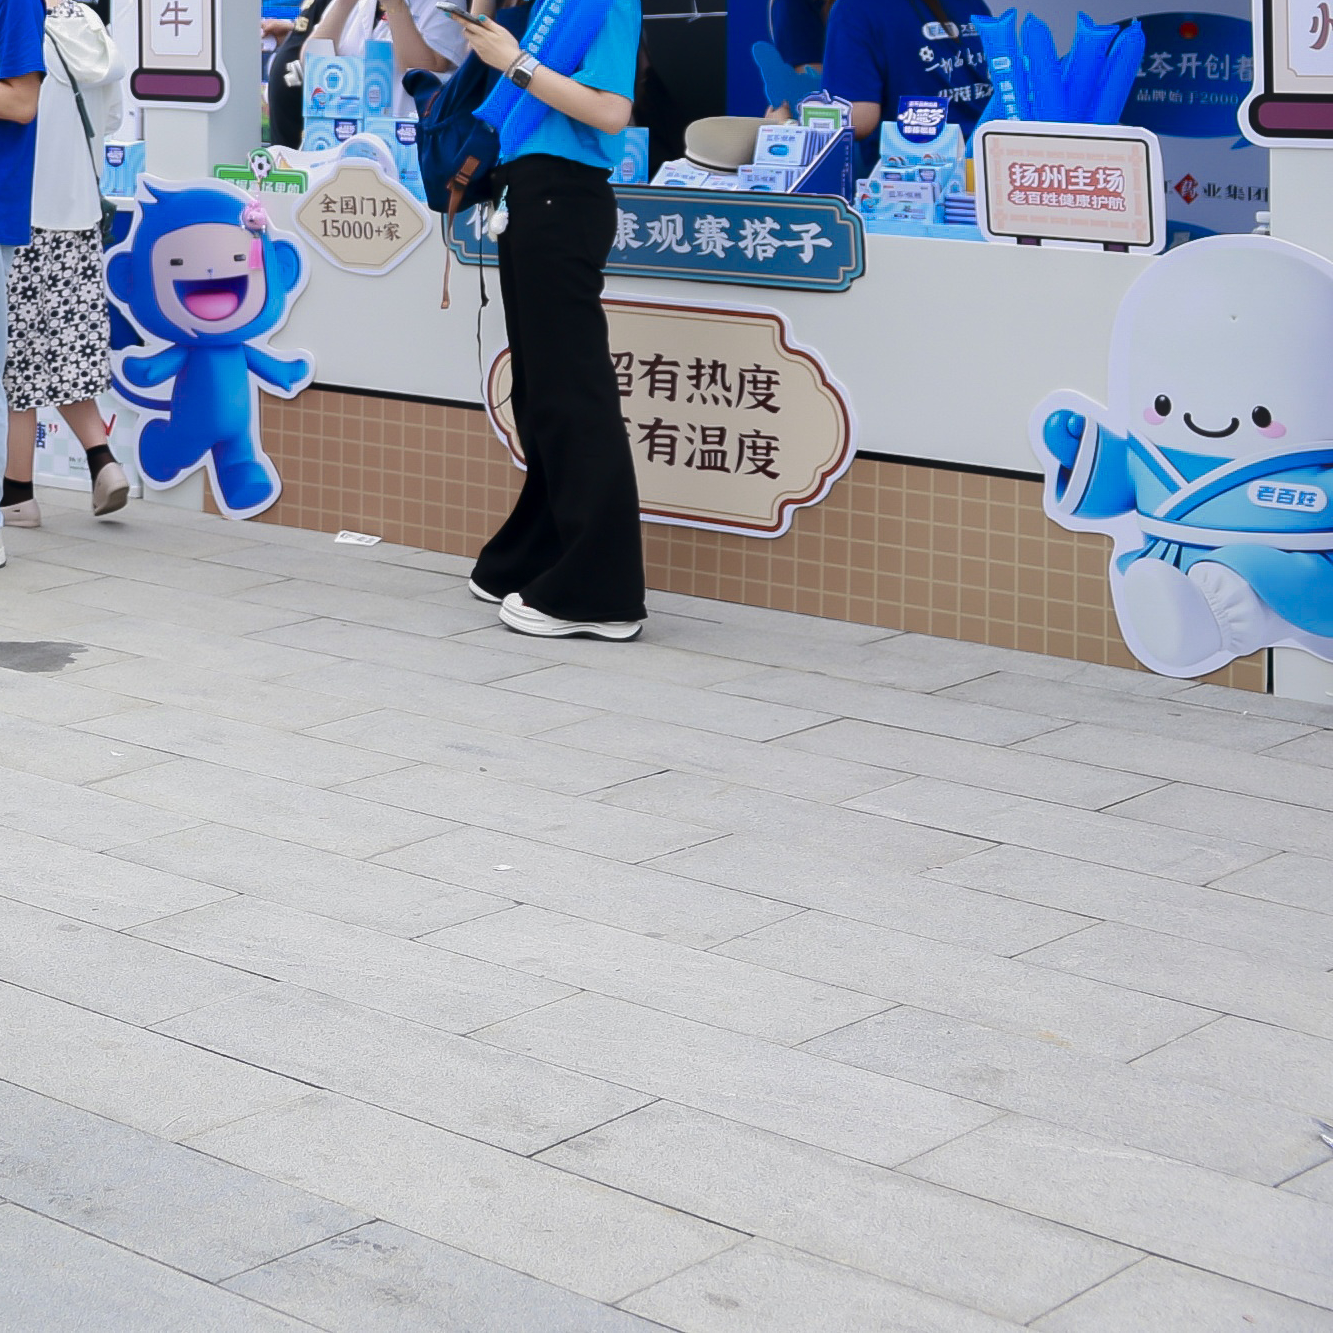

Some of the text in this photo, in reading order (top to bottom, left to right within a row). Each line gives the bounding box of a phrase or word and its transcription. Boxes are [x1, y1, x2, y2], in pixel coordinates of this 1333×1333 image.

[1010, 163, 1125, 193] 扬州主场
[319, 194, 398, 218] 全国门店
[1010, 190, 1126, 212] 老百姓健康护航
[321, 219, 401, 241] 15000+家
[622, 416, 781, 480] 有温度
[1256, 485, 1318, 508] 老百姓
